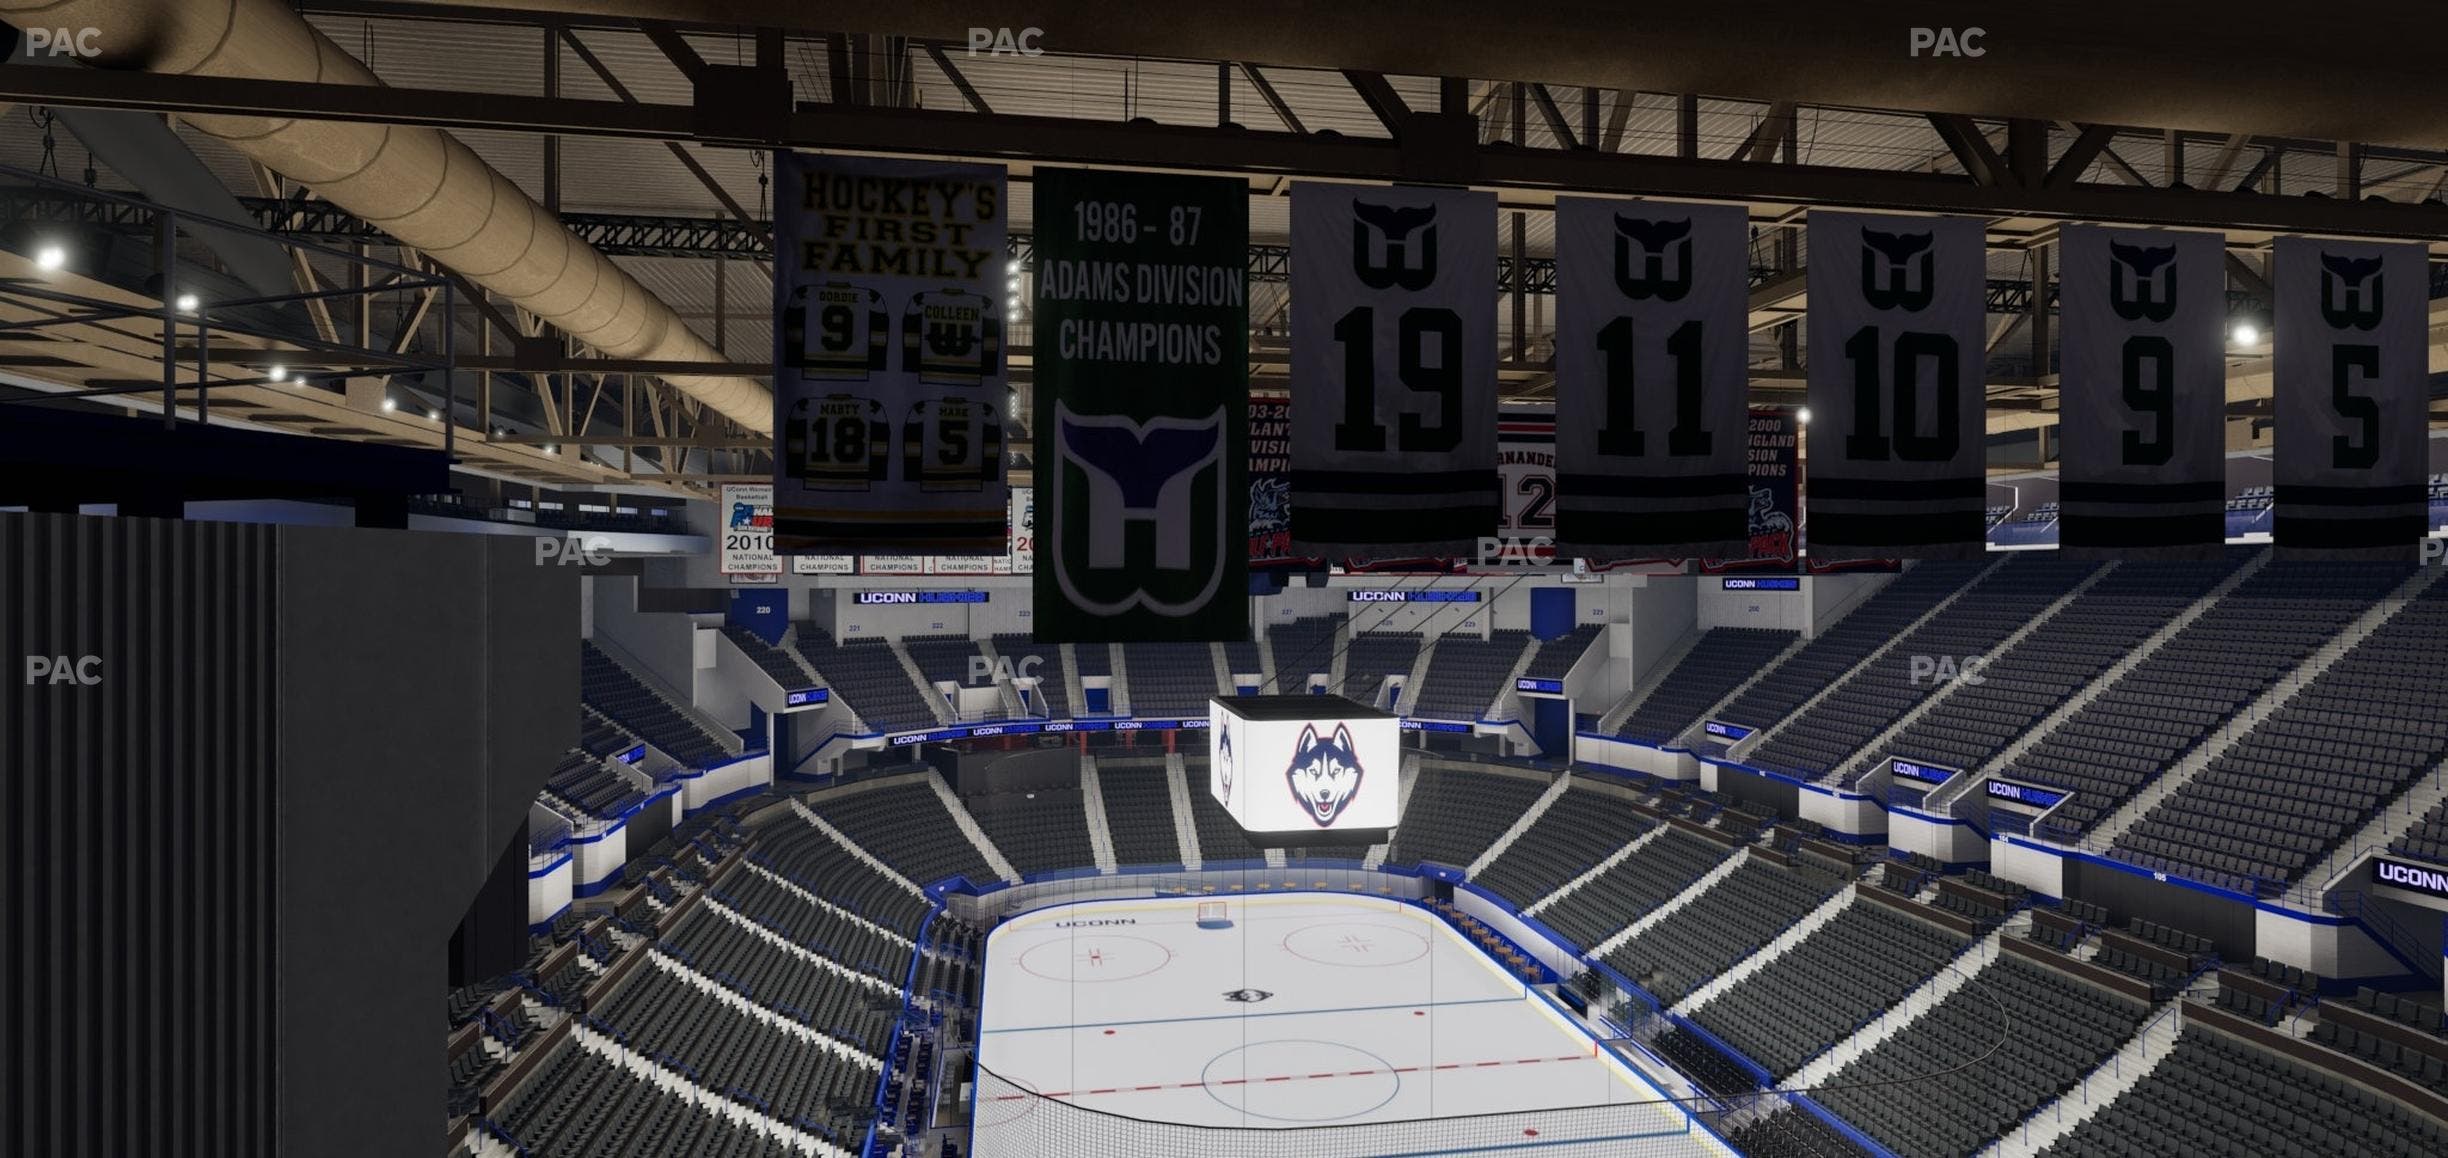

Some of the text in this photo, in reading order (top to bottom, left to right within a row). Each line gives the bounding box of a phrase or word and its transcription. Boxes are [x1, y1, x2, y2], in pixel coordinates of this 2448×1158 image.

[804, 172, 996, 220] HOCKEY'S
[826, 215, 974, 246] FIRST
[1073, 201, 1137, 244] 1986
[1168, 205, 1202, 246] 87
[803, 242, 989, 278] FAMILY
[1040, 258, 1243, 307] ADAMS DIVISION
[925, 304, 980, 321] COLLEEN
[821, 305, 853, 351] 9
[1058, 317, 1223, 366] CHAMPIONS
[1334, 306, 1463, 452] 19
[1597, 315, 1712, 457] 11
[1845, 325, 1960, 463] 10
[2121, 336, 2174, 466] 9
[820, 403, 860, 417] MARTY
[2331, 344, 2380, 469] 5
[811, 417, 866, 463] 18
[938, 419, 969, 466] 5
[726, 535, 774, 550] 2010
[727, 563, 778, 571] CHAMPIONS
[800, 563, 849, 571] CHAMPIONS
[870, 563, 918, 571] CHAMPIONS
[941, 563, 988, 571] CHAMPIONS
[1725, 579, 1756, 588] UCONN
[860, 592, 916, 603] UCONN
[1352, 592, 1405, 601] UCONN
[756, 606, 771, 614] 220
[973, 727, 1003, 736] UCONN
[1045, 723, 1073, 731] UCONN
[1183, 720, 1210, 728] UCONN
[893, 733, 927, 745] UCONN
[1893, 761, 1920, 777] UCONN
[1989, 781, 2021, 799] UCONN
[2379, 861, 2448, 894] UCONN
[1056, 919, 1136, 927] UCONN
